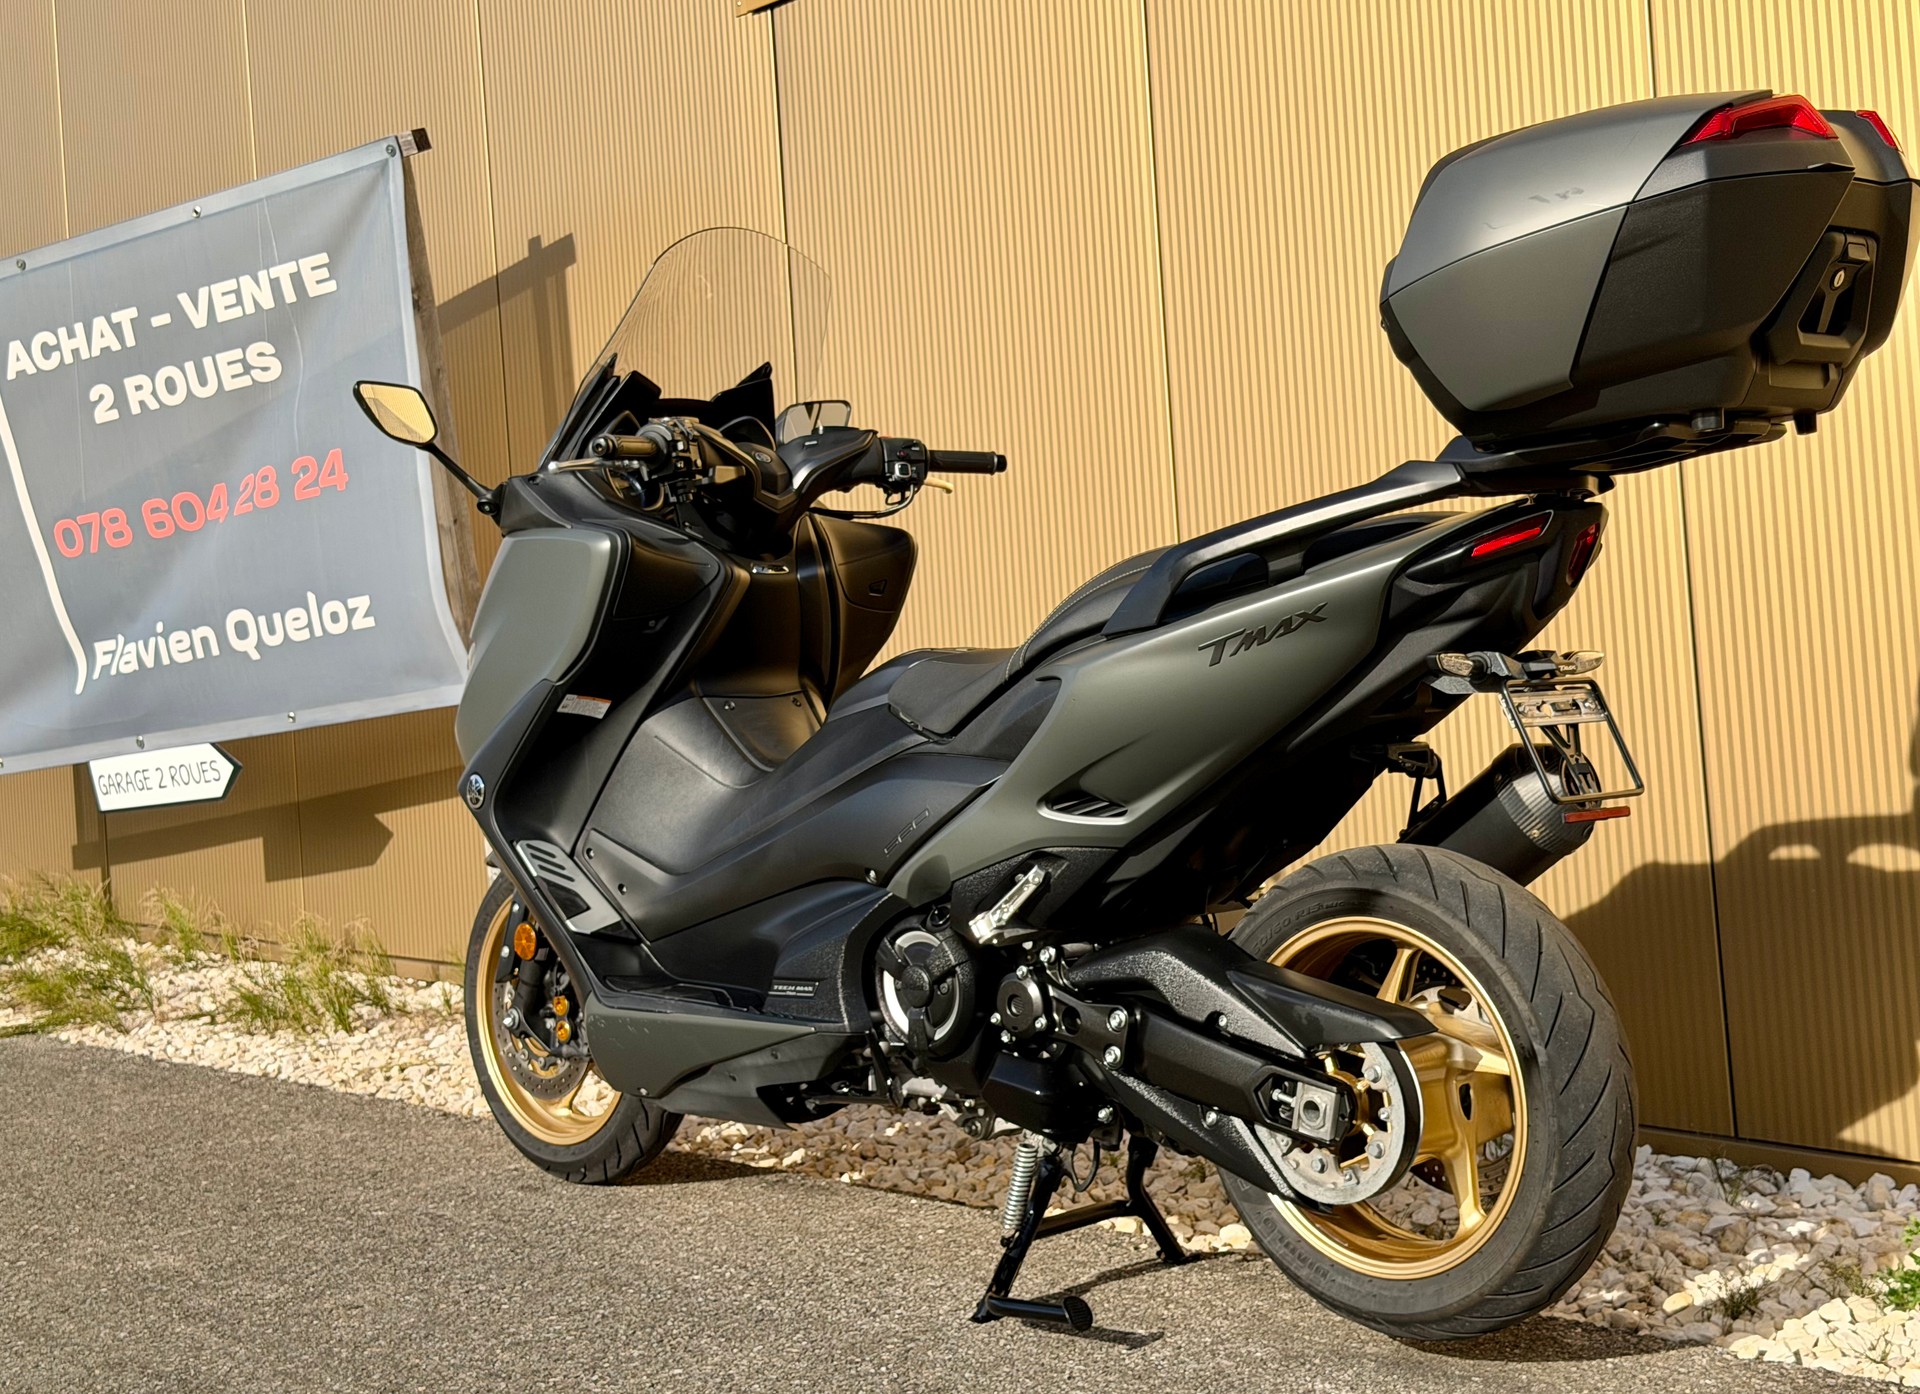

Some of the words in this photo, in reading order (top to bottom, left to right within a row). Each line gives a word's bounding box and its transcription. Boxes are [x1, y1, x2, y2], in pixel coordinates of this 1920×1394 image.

[6, 307, 139, 380] ACHAT
[177, 252, 338, 329] VENTE
[89, 384, 119, 424] 2
[124, 341, 282, 415] ROUES
[53, 507, 133, 558] 078
[291, 448, 349, 502] 24
[92, 621, 220, 680] Flavien
[225, 590, 376, 661] Queloz
[1198, 602, 1328, 667] TMAX
[98, 768, 153, 796] GARAGE
[155, 766, 168, 789] 2
[168, 760, 222, 788] ROUES
